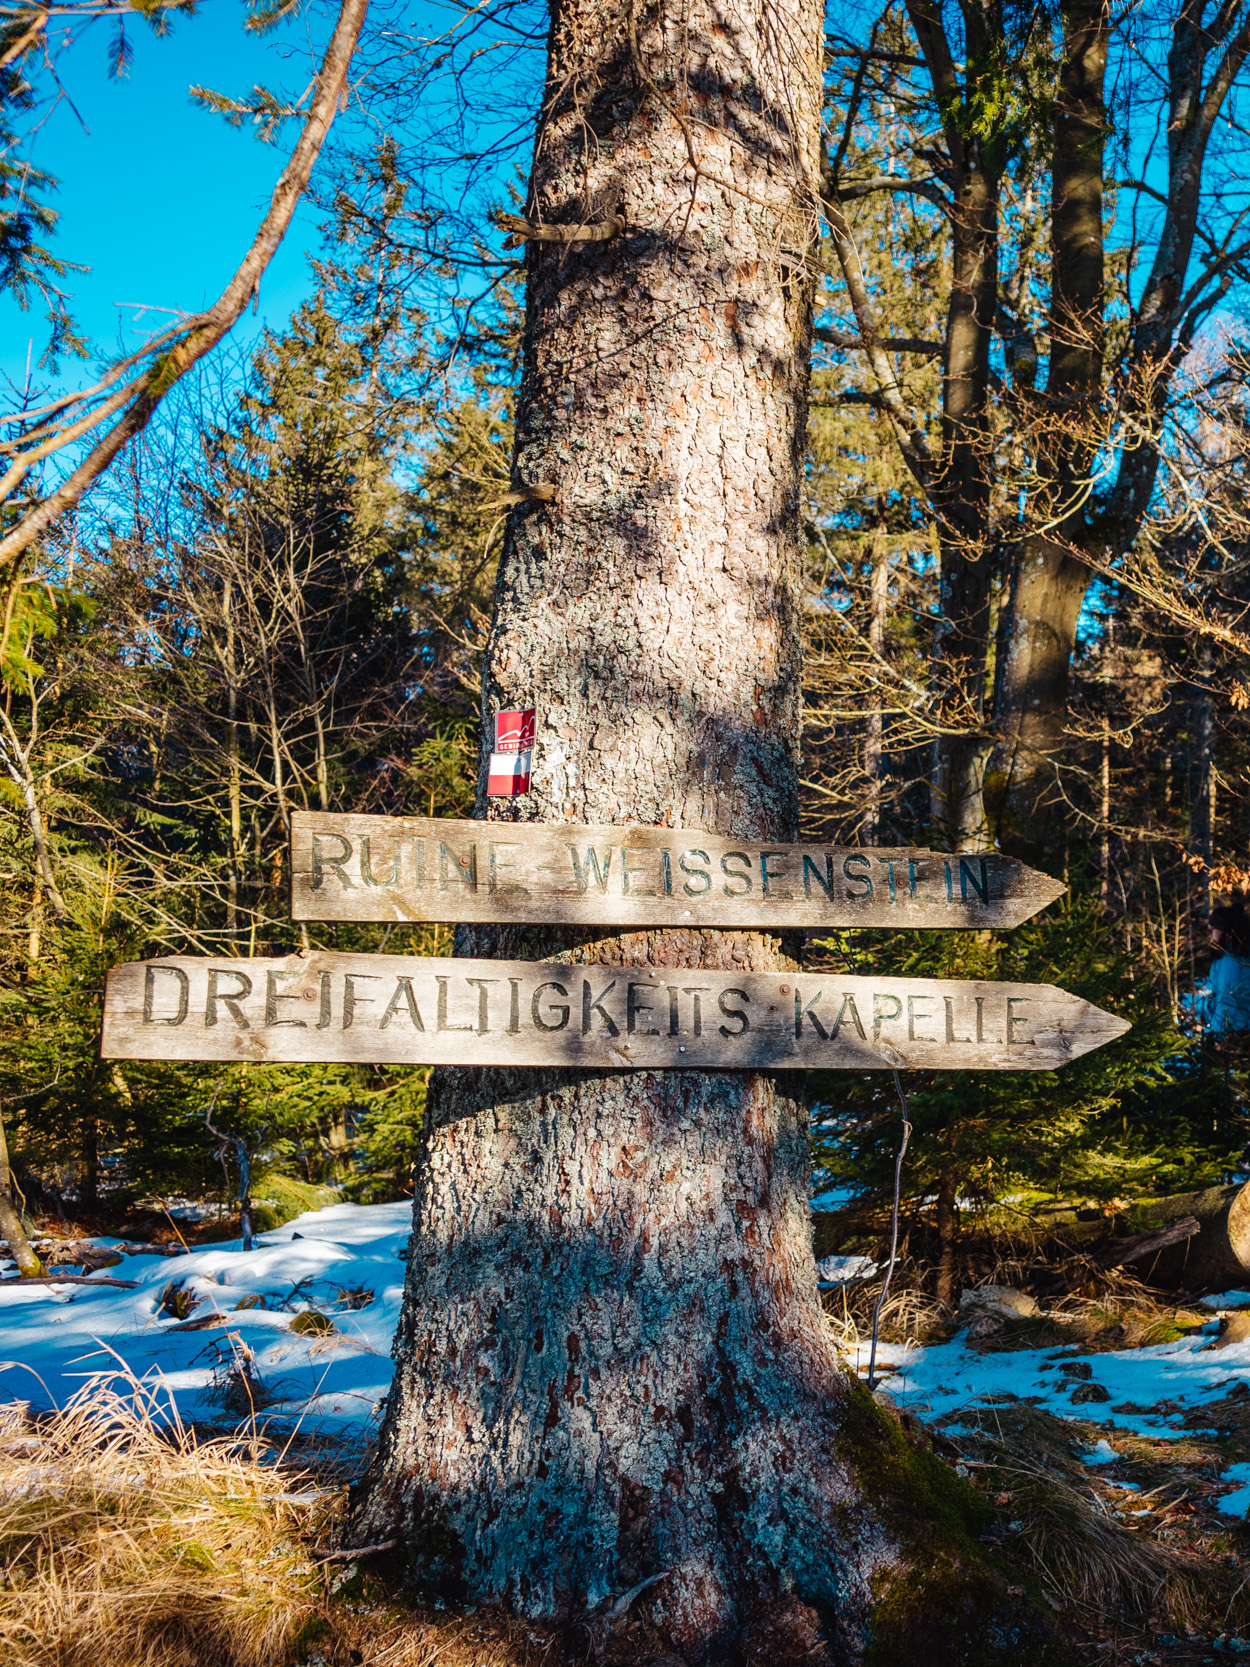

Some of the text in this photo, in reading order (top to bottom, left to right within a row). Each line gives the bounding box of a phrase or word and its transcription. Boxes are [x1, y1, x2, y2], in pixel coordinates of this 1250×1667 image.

[311, 832, 529, 895] RUINE
[565, 842, 989, 905] WEISSENSTEIN
[142, 964, 1036, 1046] DREIFALTIGKEITS KAPELLE
